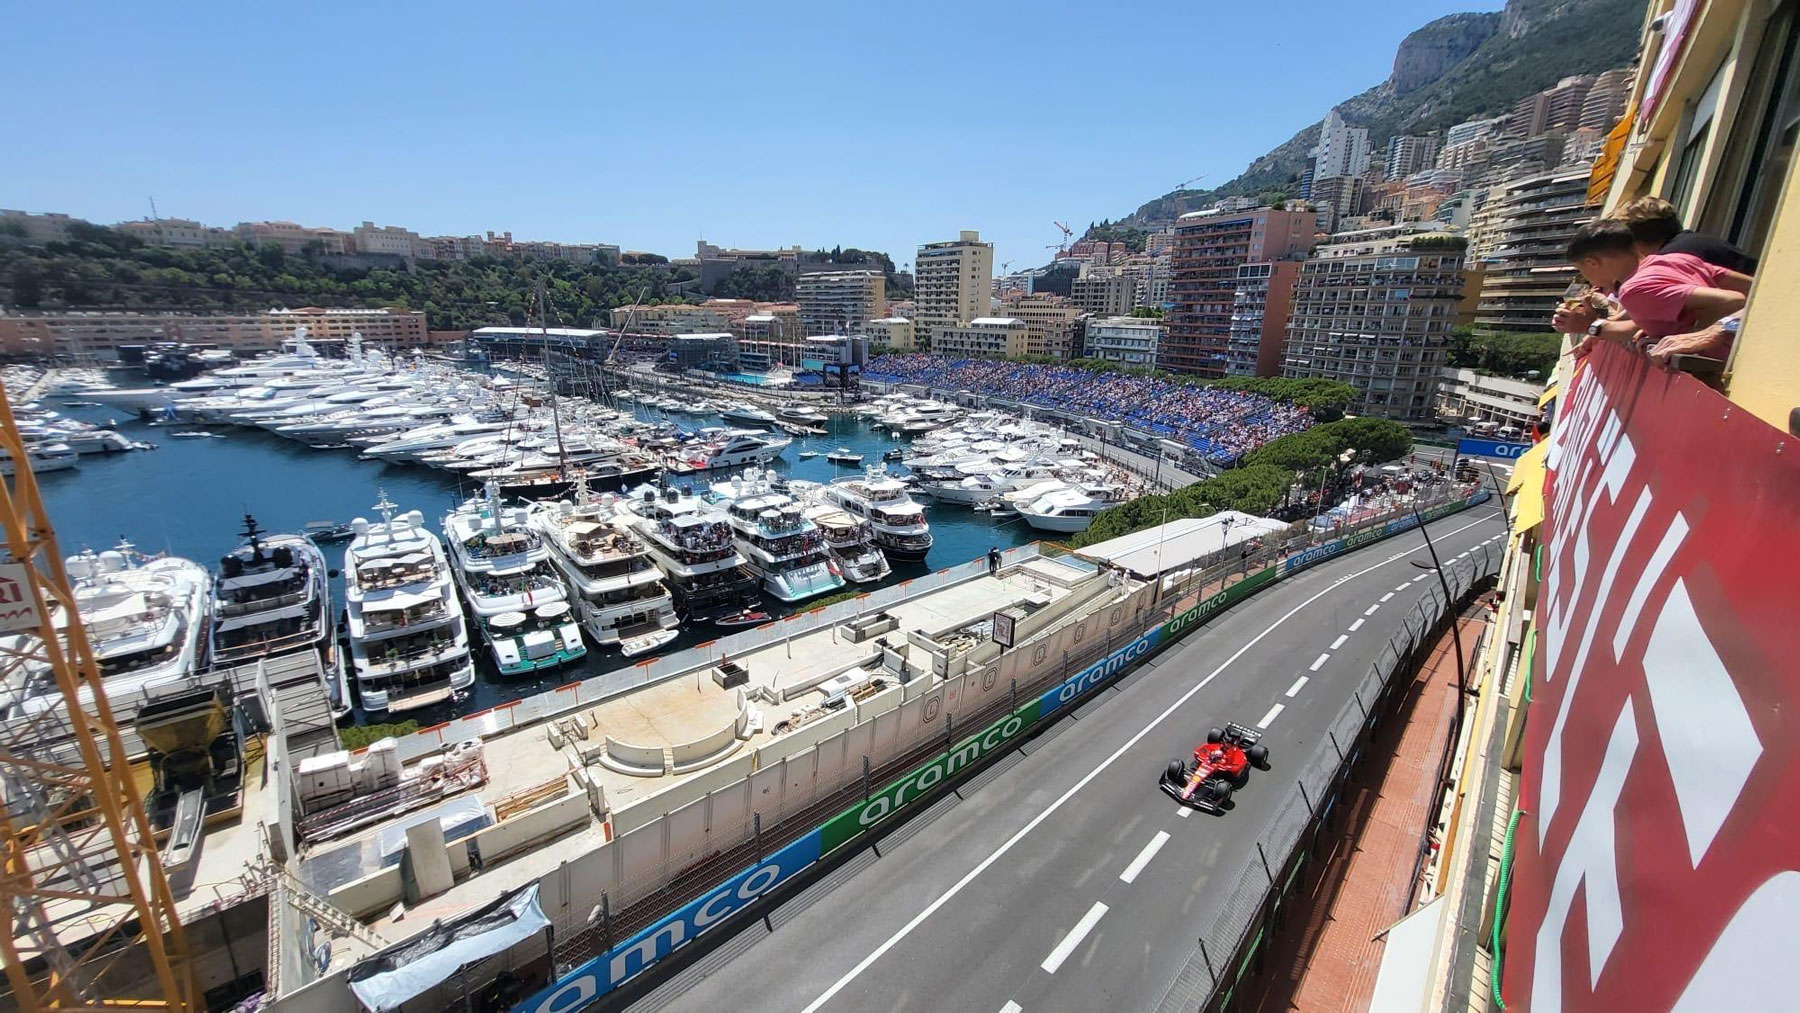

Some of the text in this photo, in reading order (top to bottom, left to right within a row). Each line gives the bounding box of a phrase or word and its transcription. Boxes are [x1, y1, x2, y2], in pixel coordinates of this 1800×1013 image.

[1293, 544, 1336, 566] aramco
[1346, 528, 1383, 547] aramco
[1170, 592, 1227, 633] aramco
[1059, 639, 1149, 702] aramco
[859, 717, 1022, 825] aramco
[521, 864, 780, 1013] amco
